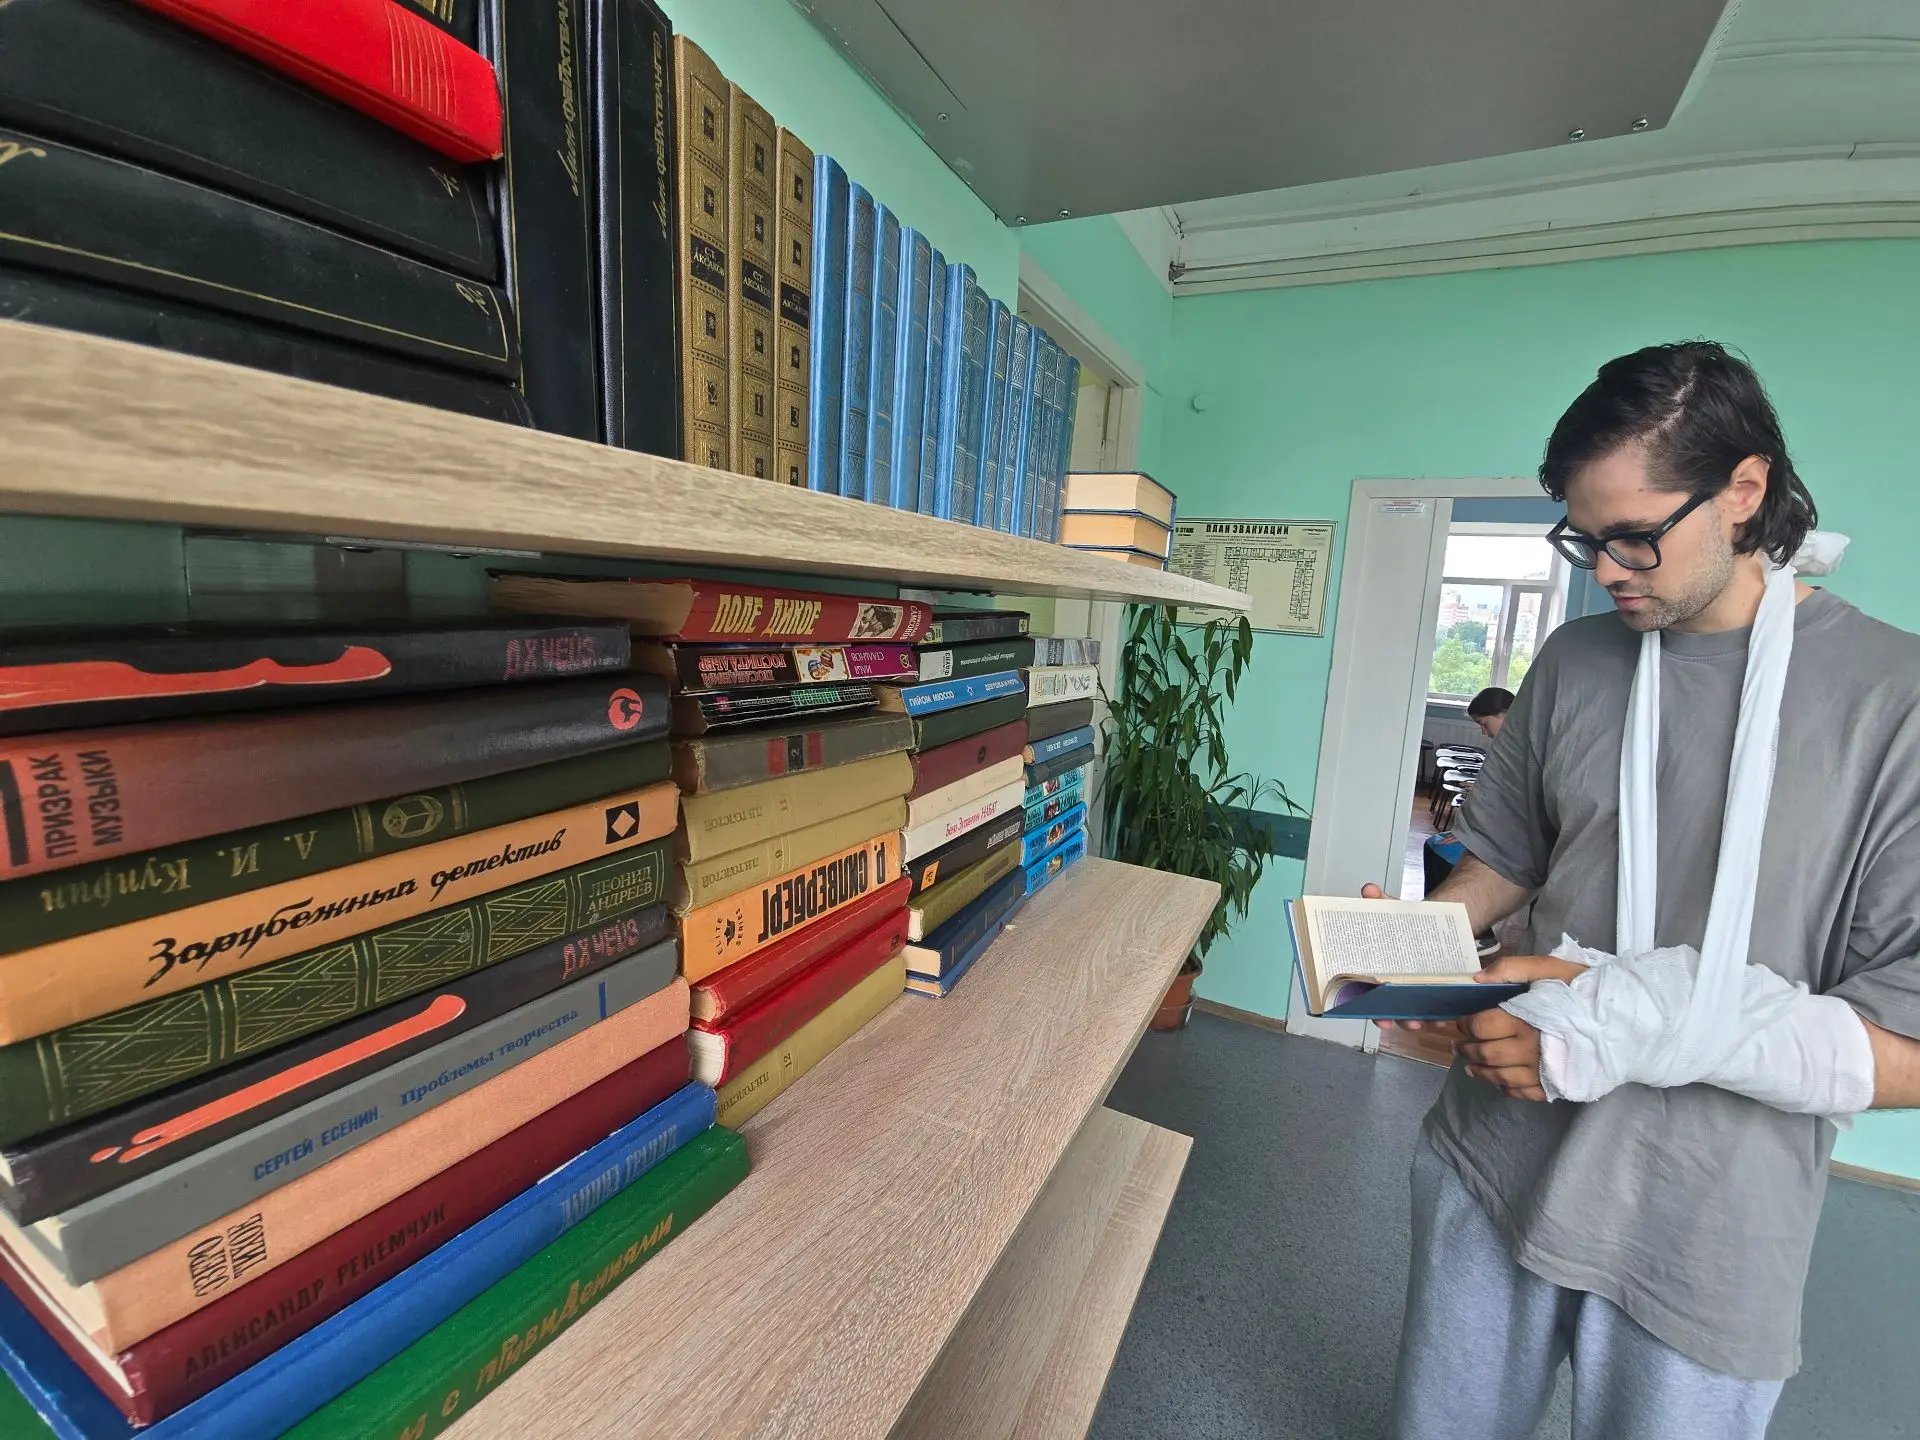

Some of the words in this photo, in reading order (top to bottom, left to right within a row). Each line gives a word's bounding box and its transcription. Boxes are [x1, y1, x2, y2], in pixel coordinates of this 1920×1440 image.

[1206, 524, 1230, 534] ПЛАН
[1232, 525, 1289, 536] ЭВАКУАЦИИ
[709, 594, 763, 634] ПОЛЕ
[760, 598, 822, 638] ДИКОЕ
[854, 665, 873, 675] ИЛЬЯ
[908, 693, 932, 707] ГИЙОМ
[932, 690, 955, 702] МЮССО
[28, 754, 78, 859] ПРИЗРАК
[78, 750, 123, 847] МУЗЫКИ
[40, 857, 191, 912] Куприн
[588, 866, 652, 899] ЛЕОНИД
[873, 842, 885, 884] Р.
[143, 880, 418, 989] Зарубежный
[430, 829, 567, 902] детектив
[585, 882, 654, 915] АНДРЕЕВ
[757, 855, 868, 943] СИЛВЕРБЕРГ
[714, 917, 723, 955] ELITE
[735, 908, 744, 946] SERIES
[253, 1137, 315, 1181] СЕРГЕЙ
[400, 1052, 496, 1106] Проблемы
[499, 1010, 579, 1057] творчества
[226, 1212, 268, 1280] ТИХОЕ
[185, 1279, 326, 1381] АЛЕКСАНДР
[338, 1204, 447, 1289] РЕКЕМЧУК
